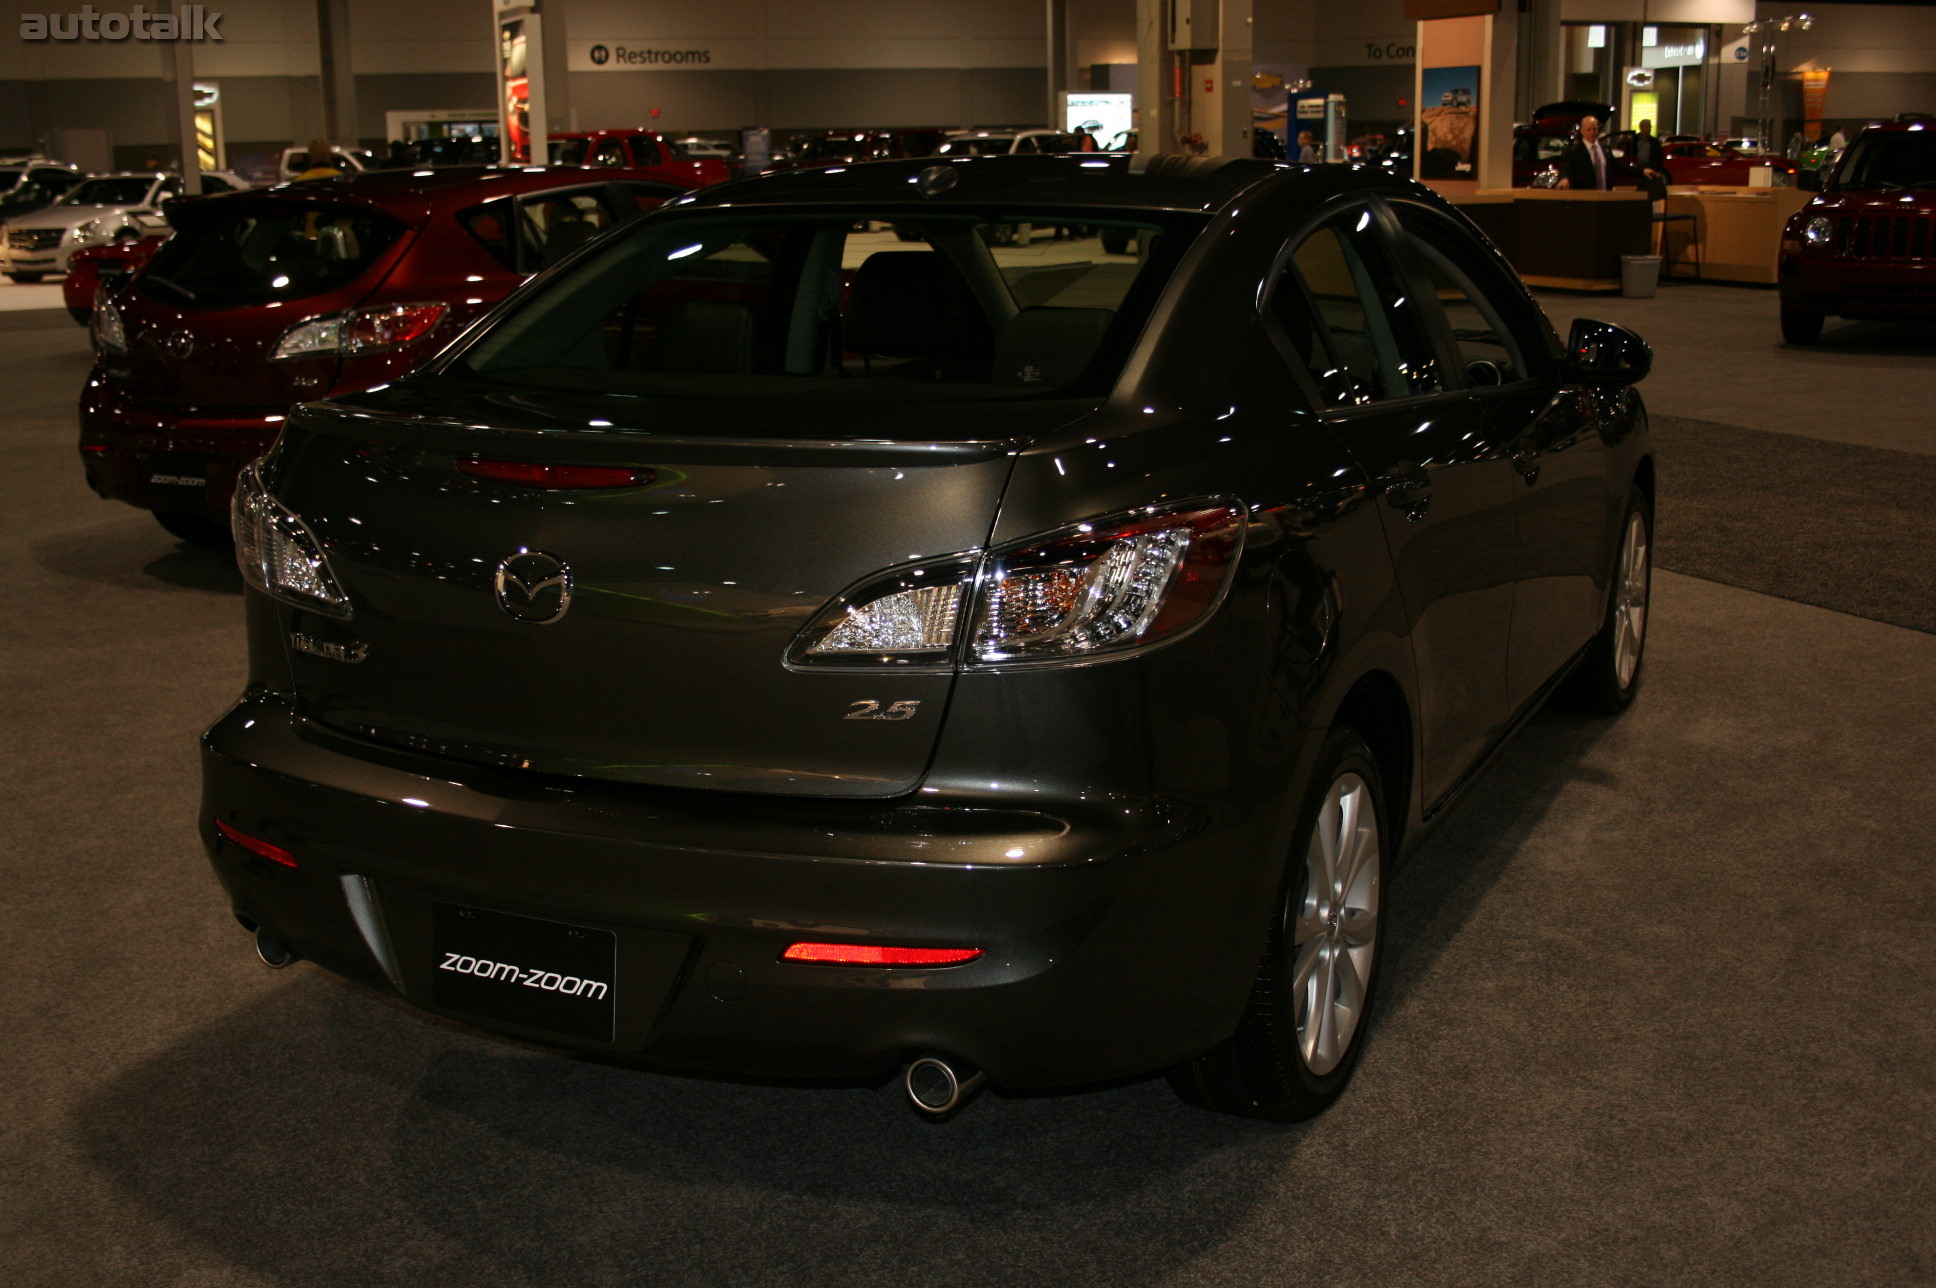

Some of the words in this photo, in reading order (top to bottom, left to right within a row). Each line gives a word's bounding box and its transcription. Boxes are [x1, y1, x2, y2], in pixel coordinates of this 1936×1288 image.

[615, 46, 711, 64] Restrooms
[1366, 44, 1382, 60] To
[842, 699, 921, 721] 2.5
